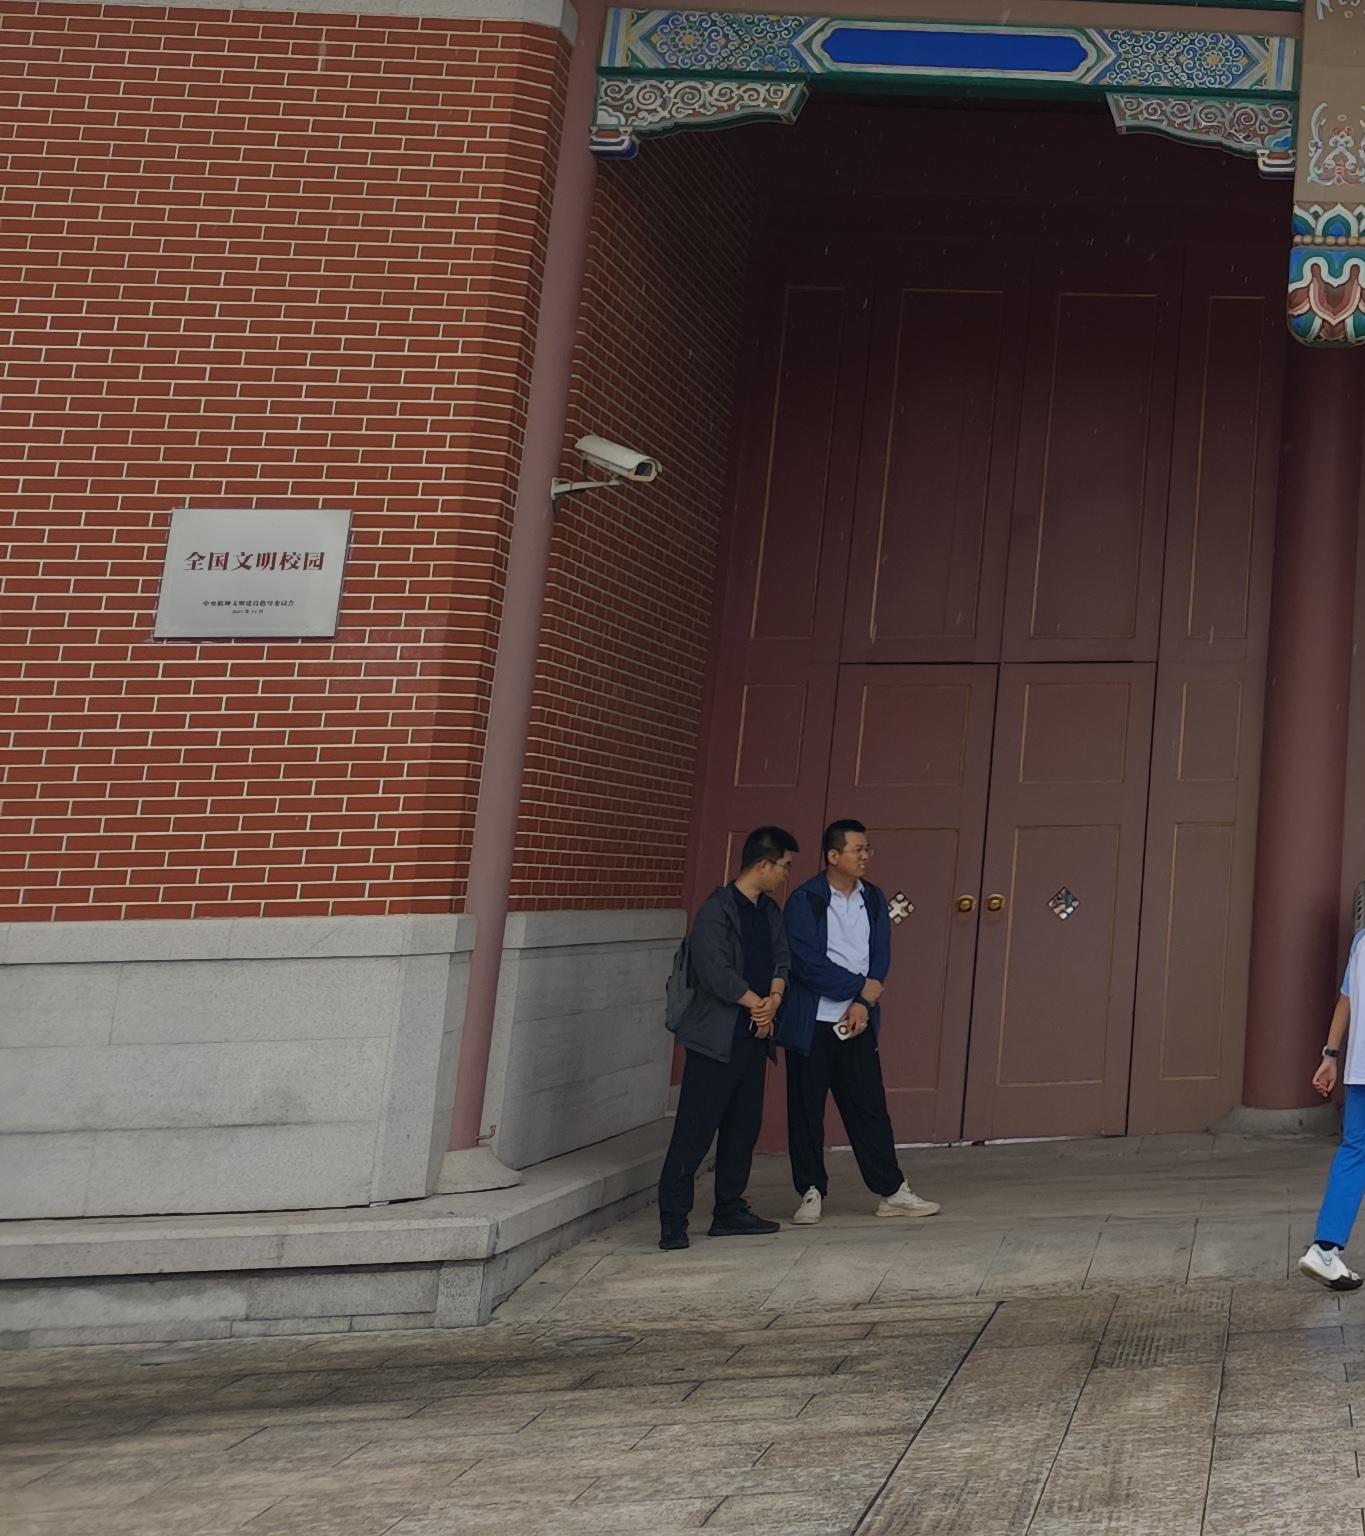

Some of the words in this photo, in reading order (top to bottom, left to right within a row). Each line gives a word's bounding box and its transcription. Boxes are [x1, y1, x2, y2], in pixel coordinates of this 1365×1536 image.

[183, 551, 326, 571] 全国文明校园
